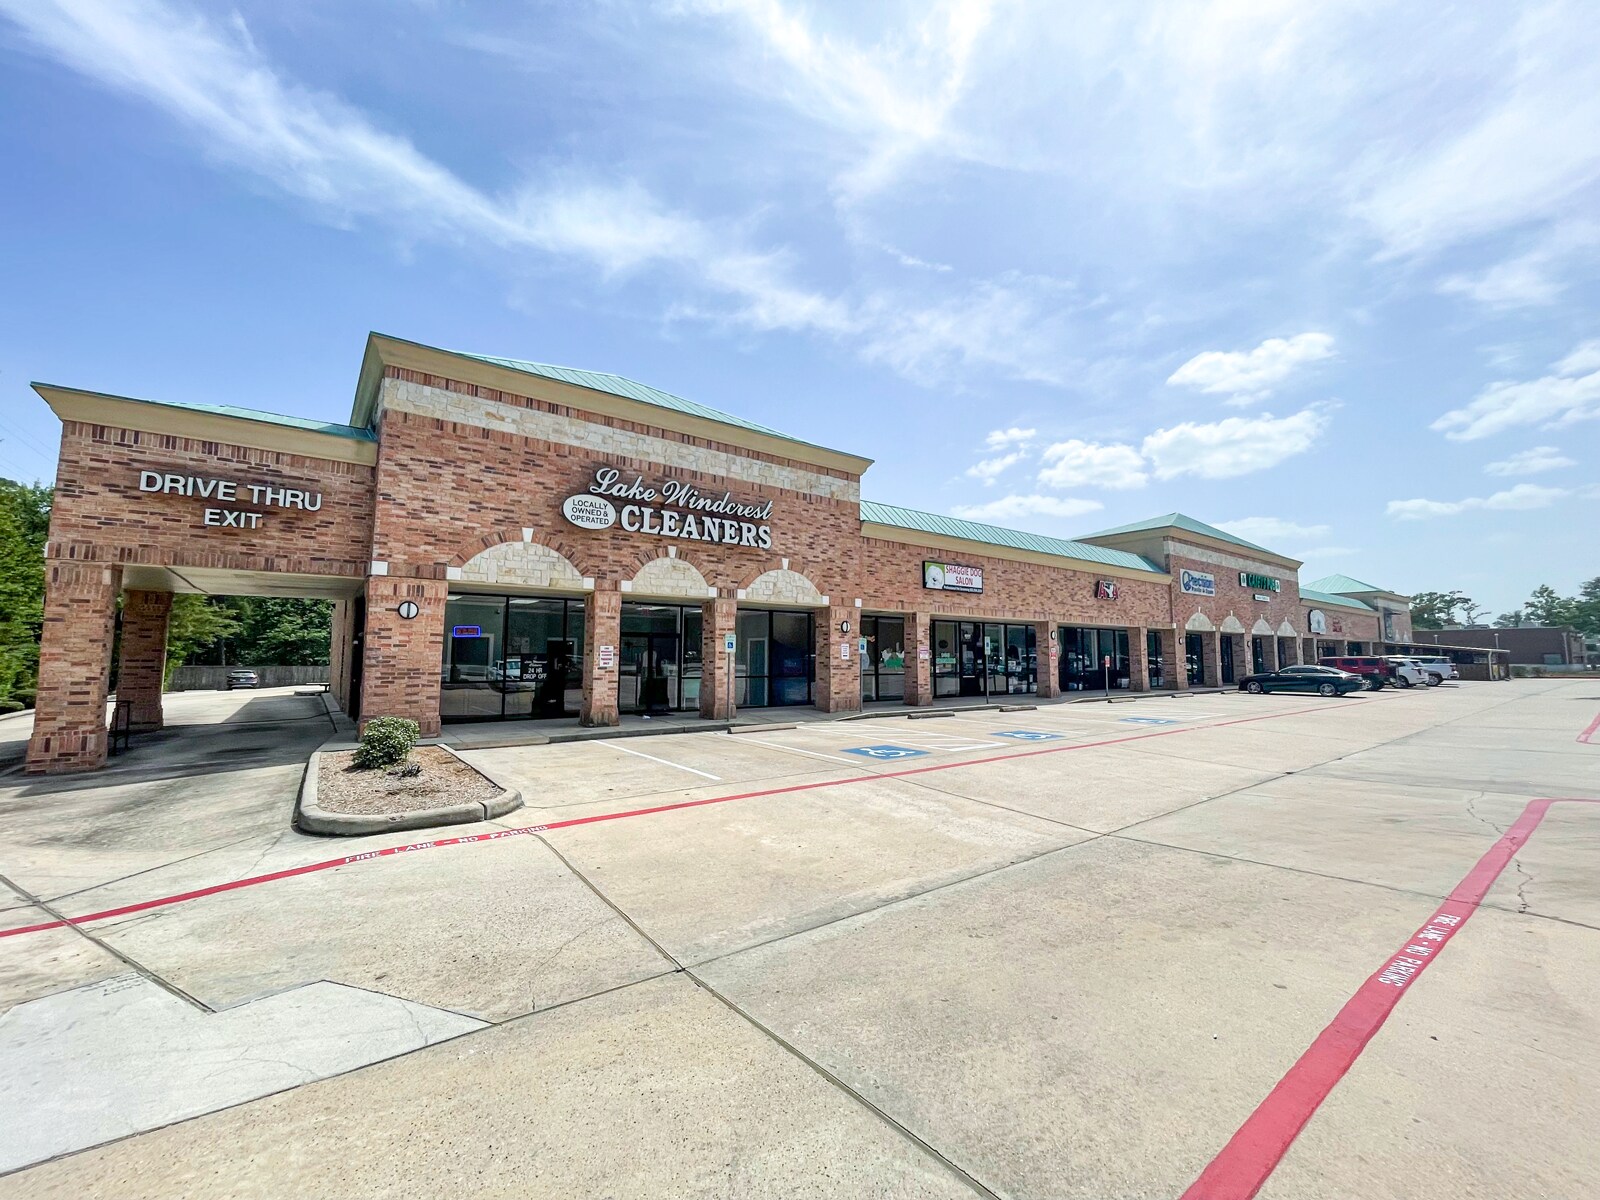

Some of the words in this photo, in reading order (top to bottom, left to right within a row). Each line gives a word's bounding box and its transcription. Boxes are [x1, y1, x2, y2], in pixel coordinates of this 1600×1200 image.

[139, 471, 237, 502] DRIVE
[247, 485, 322, 511] THRU
[590, 467, 657, 501] Lake
[662, 480, 773, 520] Windcrest
[571, 507, 602, 517] OWNED
[572, 499, 608, 511] LOCALLY
[204, 508, 262, 529] EXIT
[571, 514, 610, 526] OPERATED
[620, 504, 772, 550] CLEANERS
[945, 565, 969, 576] SHAGGIE
[970, 568, 982, 577] DOG
[955, 576, 973, 585] SALON
[345, 851, 381, 864] FIRE
[394, 842, 436, 853] LANE
[490, 825, 549, 839] PARKING
